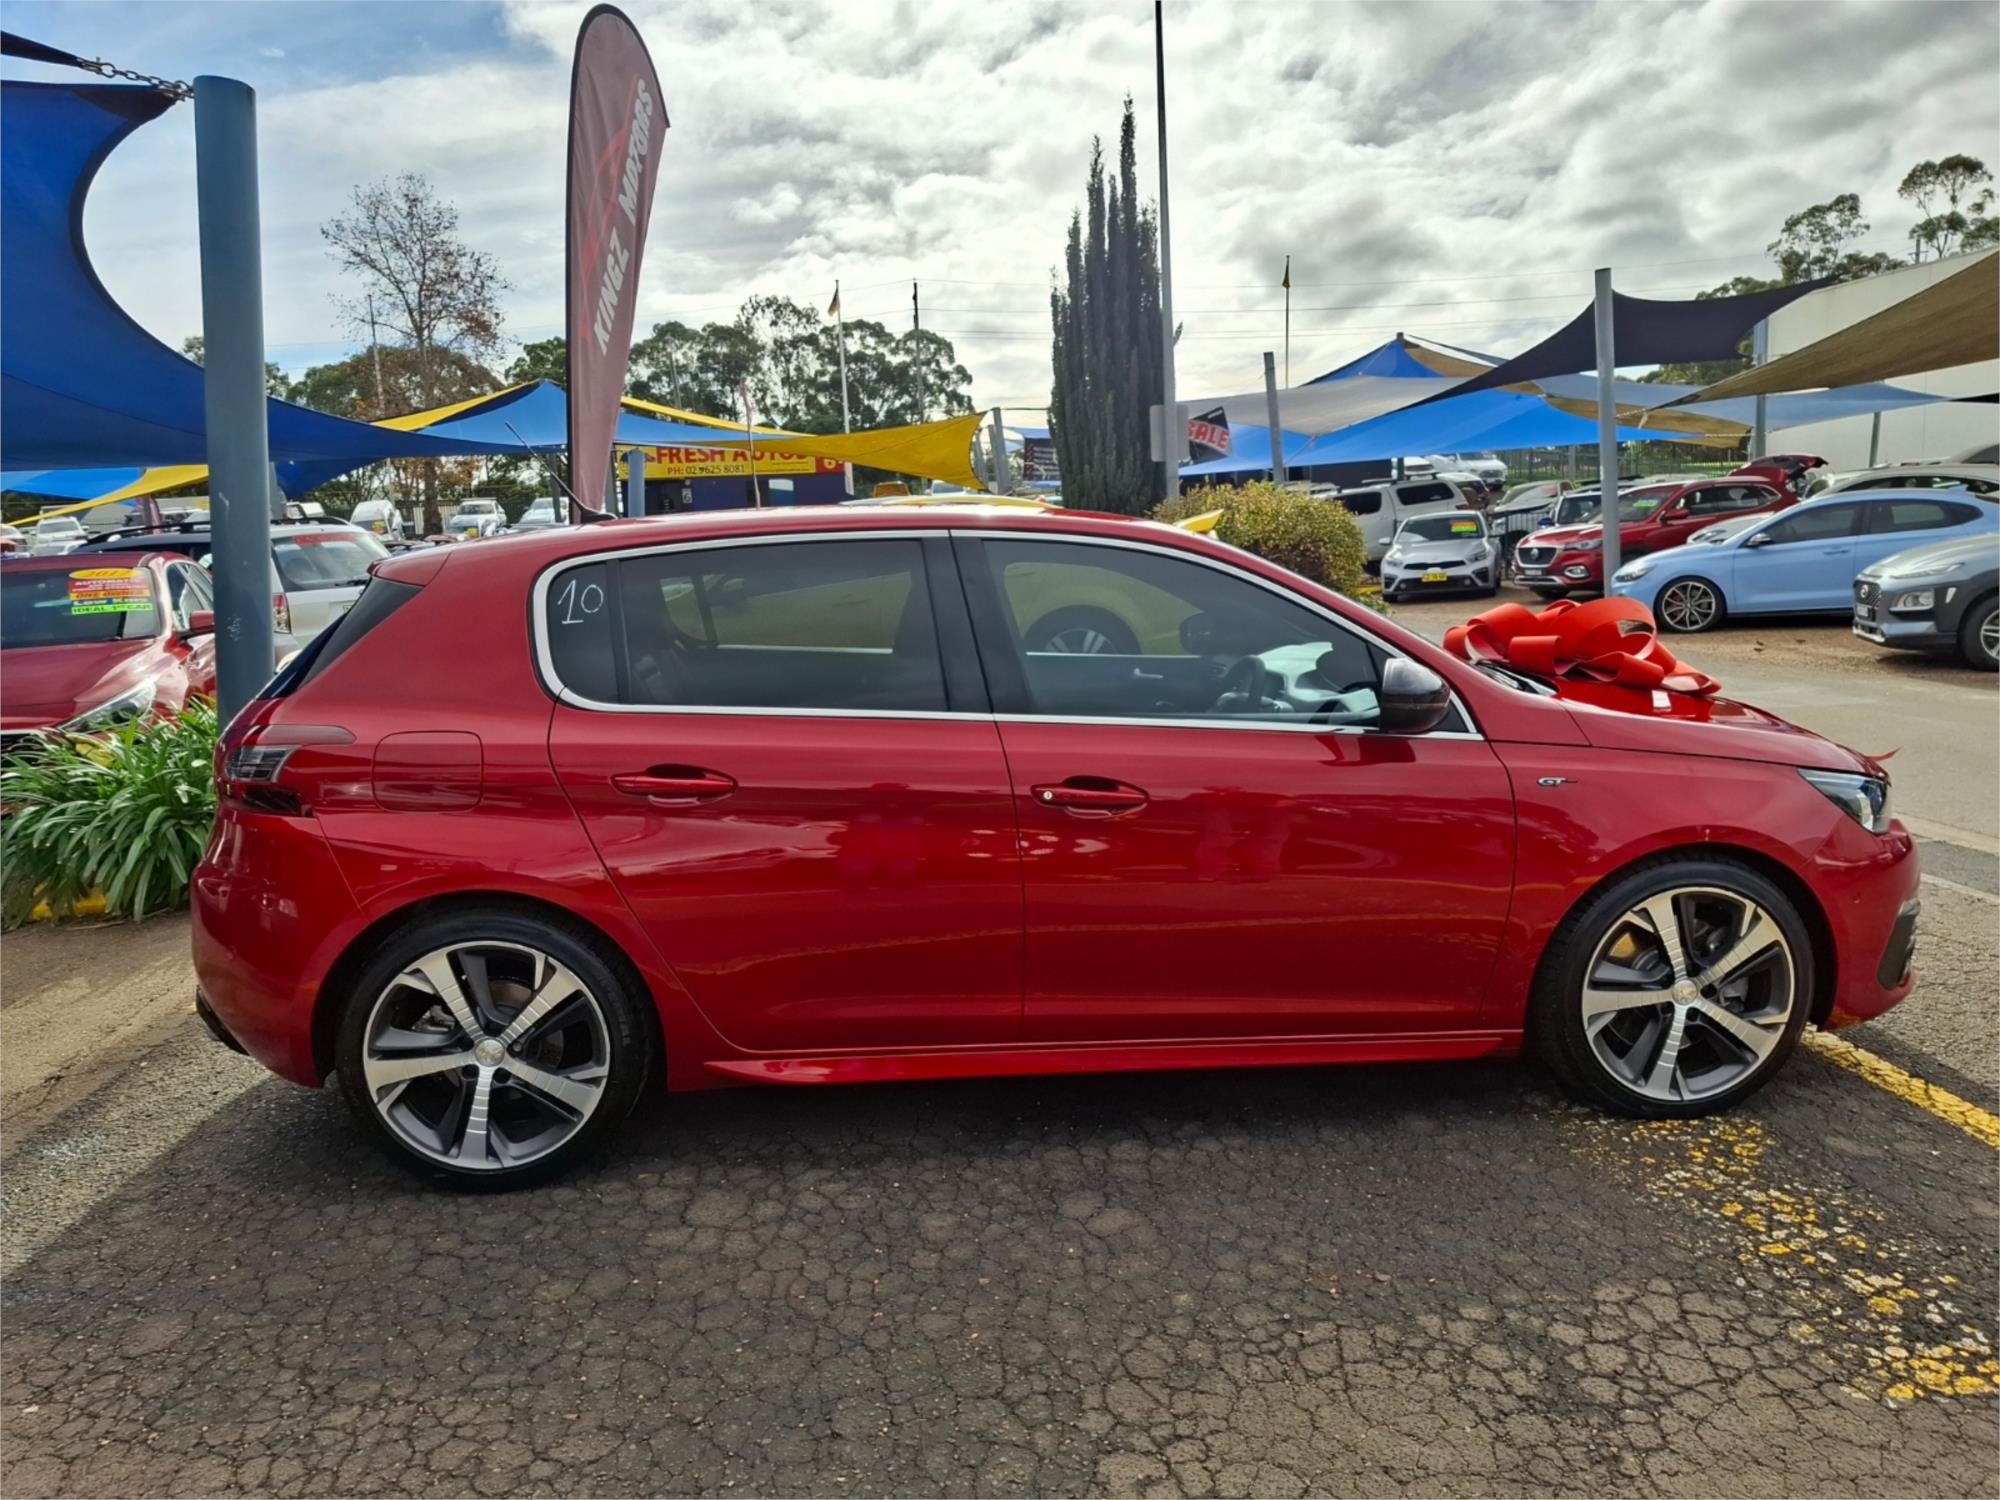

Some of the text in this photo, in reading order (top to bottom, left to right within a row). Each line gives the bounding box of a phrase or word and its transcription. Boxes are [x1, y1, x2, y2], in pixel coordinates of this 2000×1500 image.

[593, 79, 653, 357] KINGZ MOTORS
[656, 447, 726, 464] FRESH
[667, 466, 684, 475] PH:
[685, 465, 696, 474] 02
[558, 579, 604, 624] 10
[1538, 776, 1568, 788] GT
